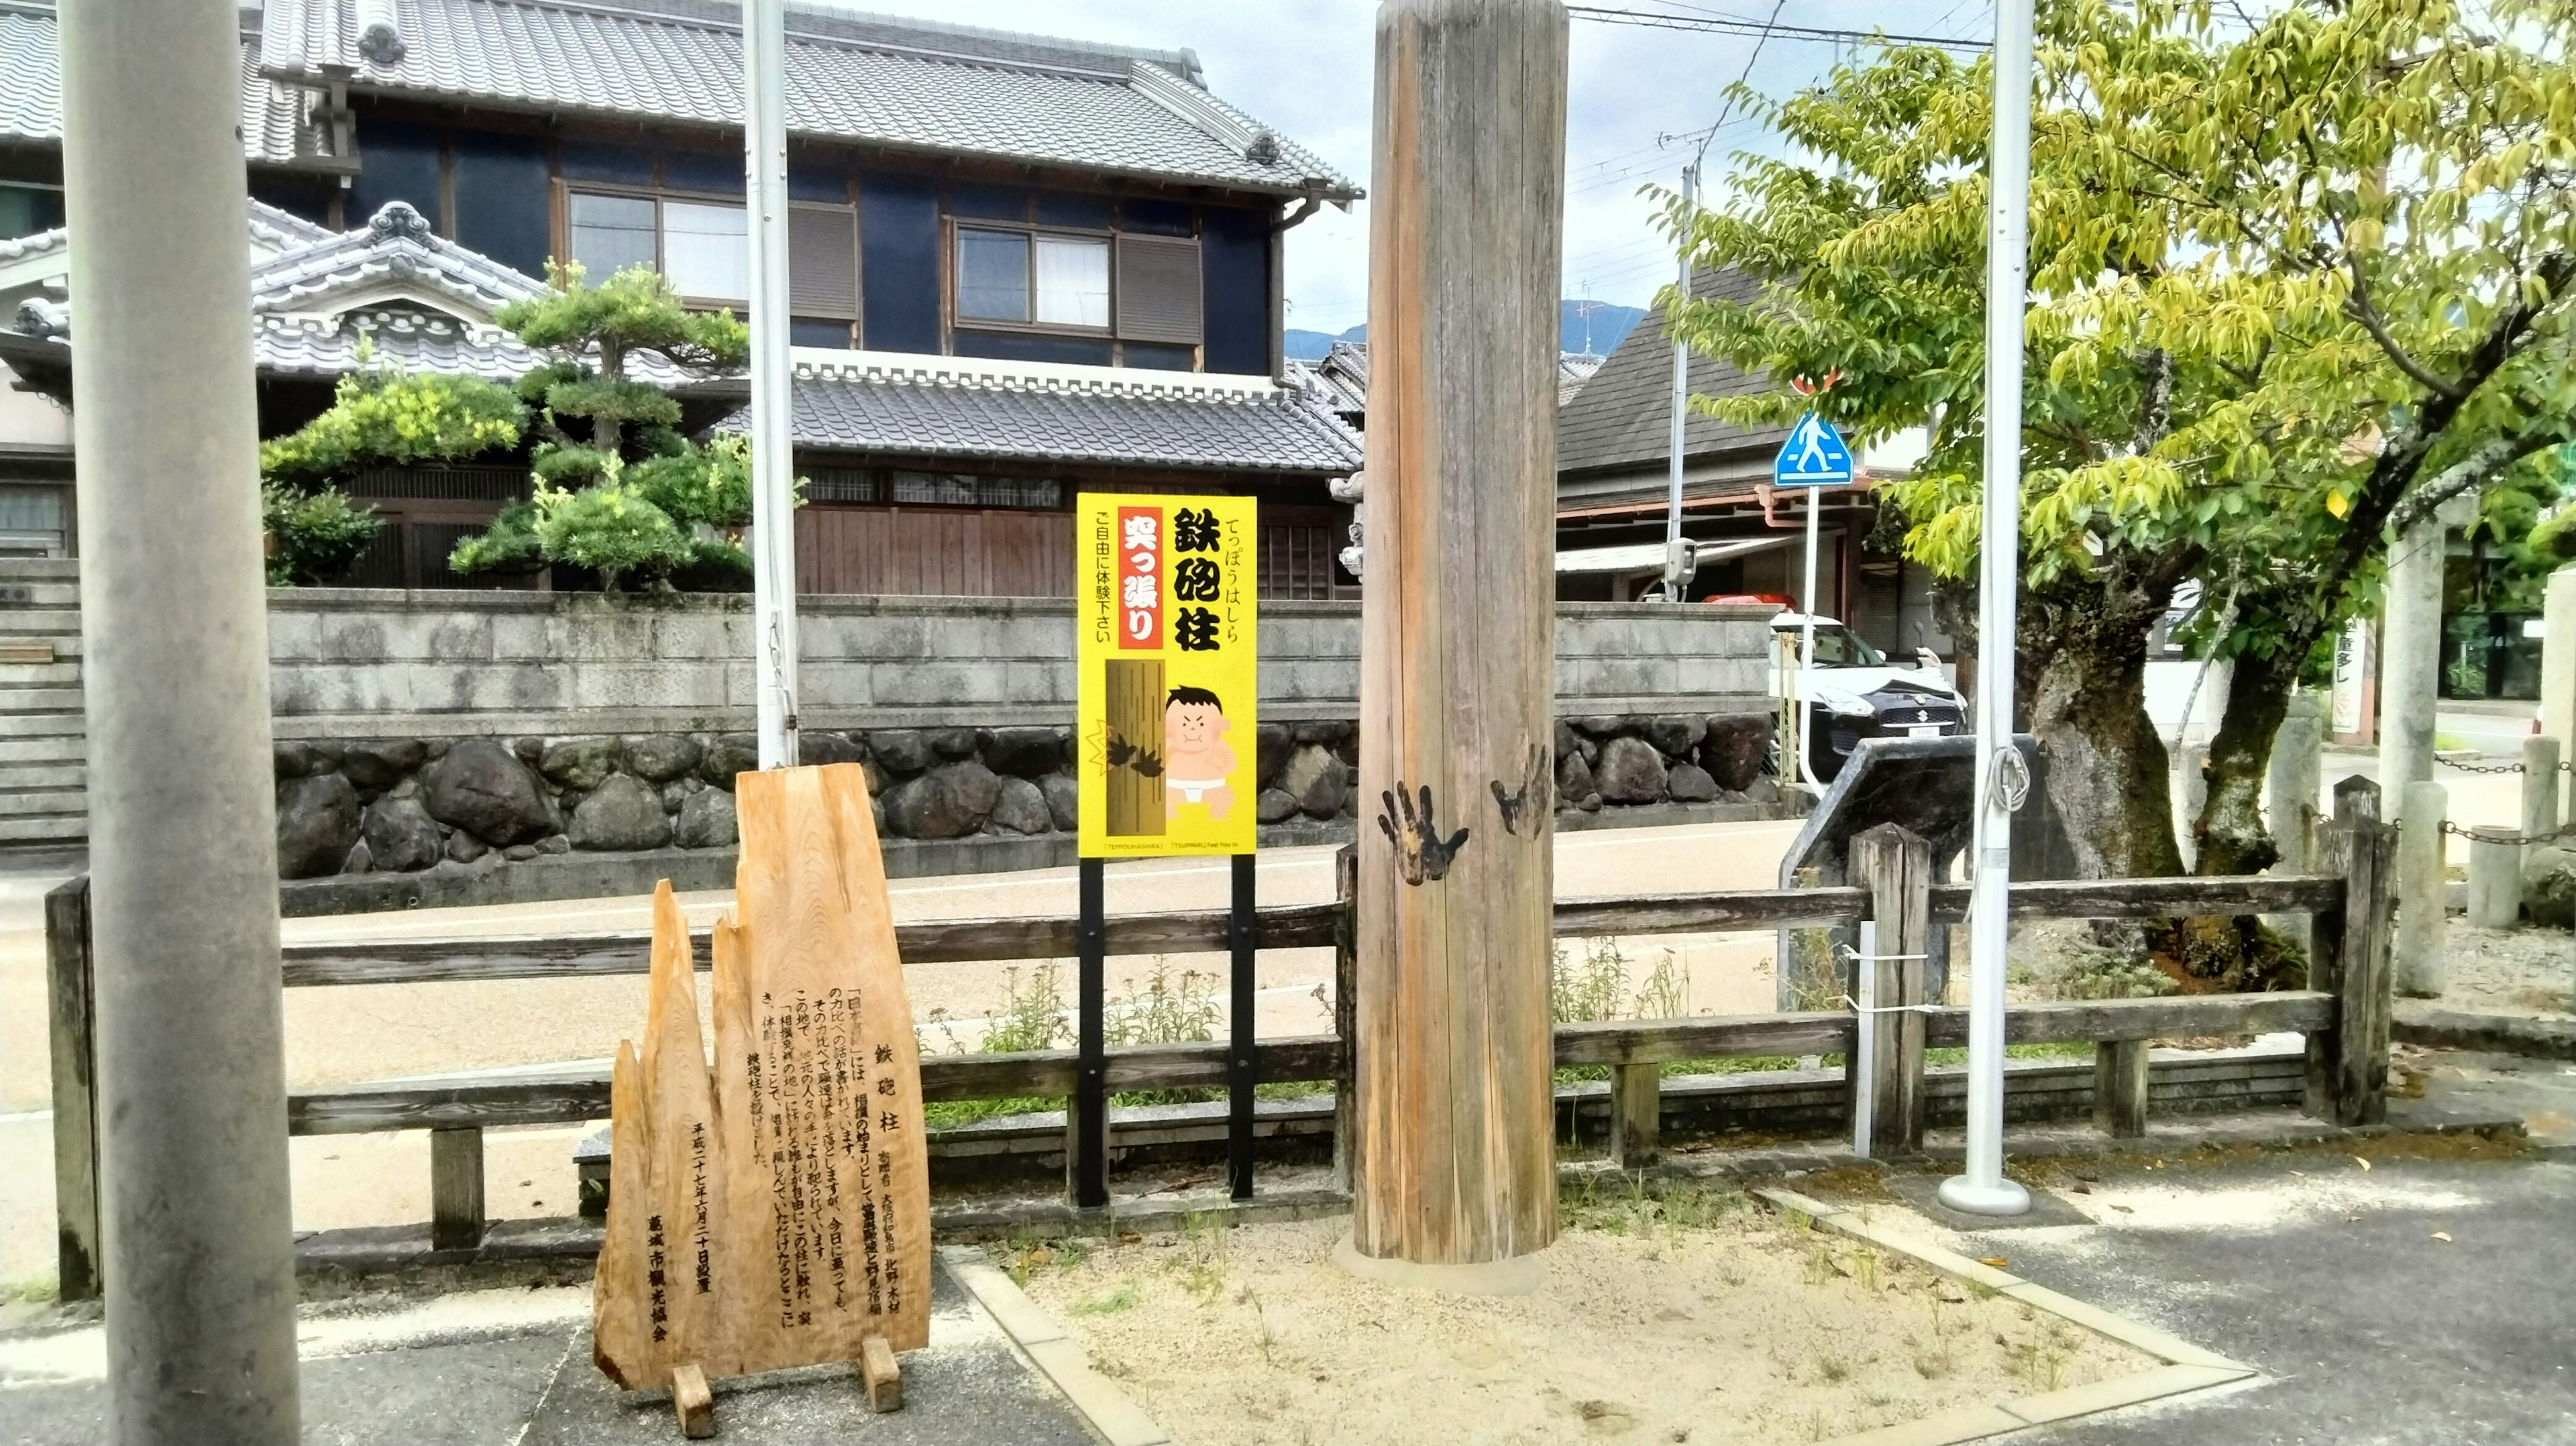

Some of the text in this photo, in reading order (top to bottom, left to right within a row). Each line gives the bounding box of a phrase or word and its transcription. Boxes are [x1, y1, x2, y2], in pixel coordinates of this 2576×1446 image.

[1096, 512, 1110, 643] ご自由に体験下さい
[1124, 516, 1157, 640] 突っ張り
[1174, 508, 1220, 651] 鉄砲柱
[1226, 519, 1243, 643] てっぽうはしら
[692, 1122, 711, 1296] 平成二十七年六月二十日設置
